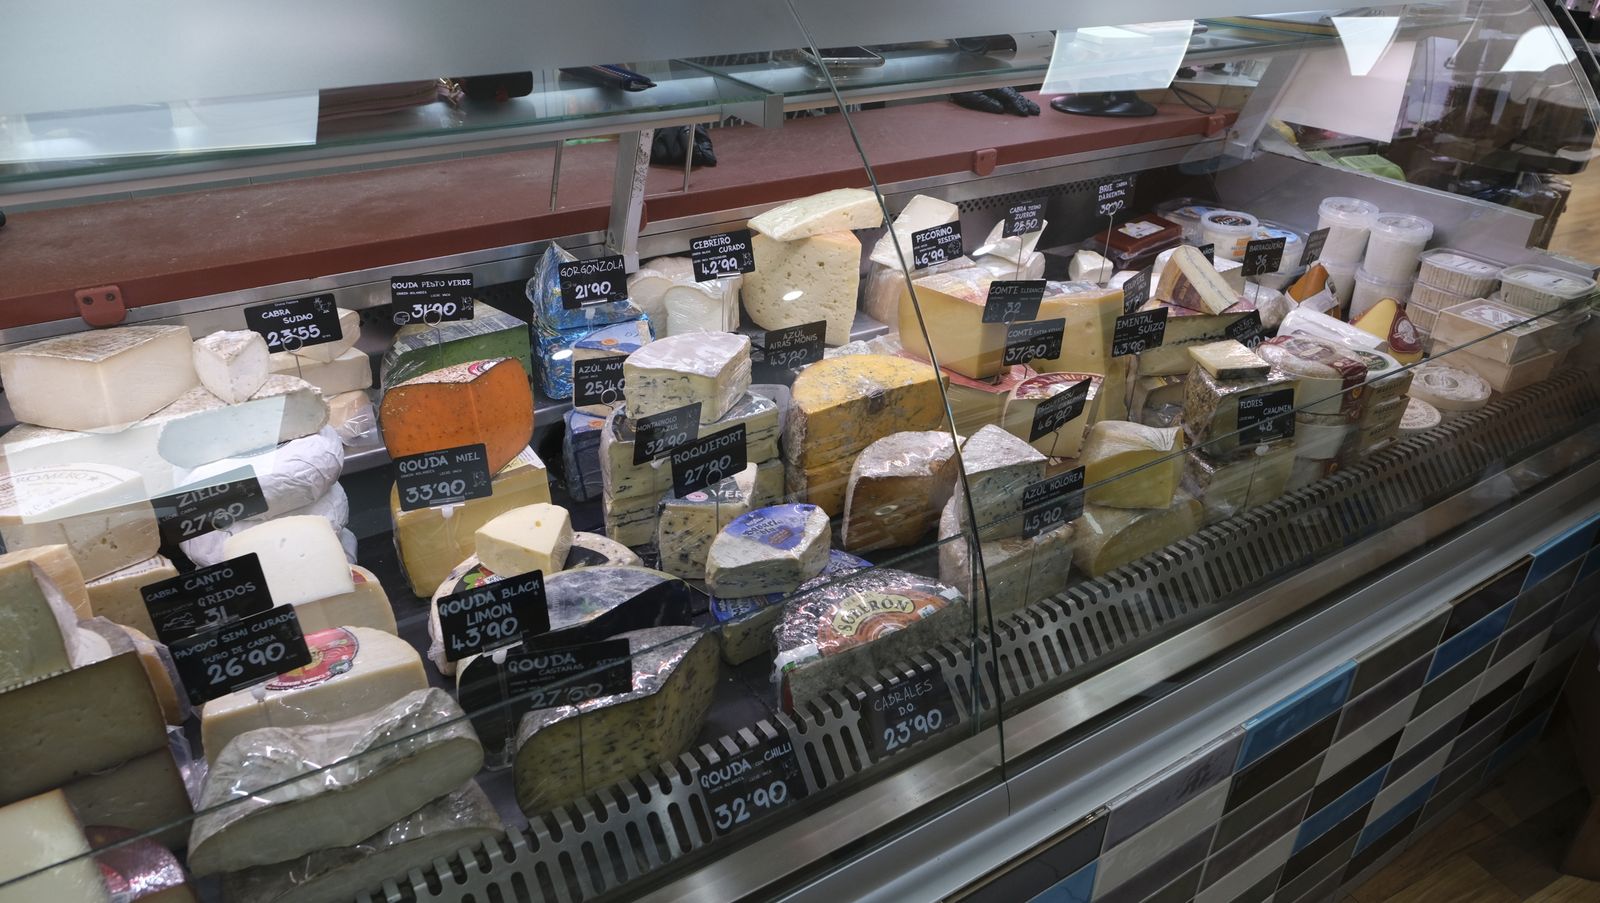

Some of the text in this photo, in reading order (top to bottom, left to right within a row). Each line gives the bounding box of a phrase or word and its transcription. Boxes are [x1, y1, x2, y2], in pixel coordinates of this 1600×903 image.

[693, 236, 731, 250] CEBREIRO
[916, 226, 952, 243] PECORINO
[938, 233, 961, 244] RESERVA
[718, 243, 746, 254] CURADO
[915, 248, 944, 266] 46'99
[560, 259, 624, 278] GORGONZOLA
[702, 257, 738, 275] 42'99
[392, 278, 472, 290] GOUDA PESTO VERDE
[575, 281, 612, 300] 21'90
[262, 309, 291, 319] CABRA
[412, 302, 456, 318] 31'90
[1116, 314, 1153, 330] EMENTAL
[1138, 321, 1164, 334] SUIZO
[267, 324, 320, 346] 23'55
[768, 340, 792, 350] AIRAS
[1240, 398, 1264, 409] FLORES
[644, 432, 688, 456] 32'90
[673, 429, 744, 465] ROQUEFORT
[399, 451, 480, 473] GOUDA MIEL
[684, 454, 732, 486] 27'90
[176, 483, 230, 508] ZIELO
[406, 479, 466, 503] 33'90
[180, 502, 244, 536] 27'90
[1024, 507, 1062, 532] 45'90
[184, 568, 234, 590] CANTO
[146, 587, 178, 602] CABRA
[198, 582, 256, 607] GREDOS
[439, 580, 539, 617] GOUDA BLACK
[466, 602, 513, 626] LIMON
[174, 639, 218, 660] PAYOYO
[221, 628, 248, 644] SEMI
[452, 617, 519, 650] 43'90
[202, 635, 277, 665] PURO DE CABRA
[208, 642, 286, 686] 26'90
[508, 653, 576, 674] GOUDA
[874, 679, 933, 712] CABRALES
[884, 708, 943, 751] 23'90
[701, 758, 752, 789] GOUDA
[764, 742, 792, 762] CHILLI
[714, 781, 787, 830] 32'90
